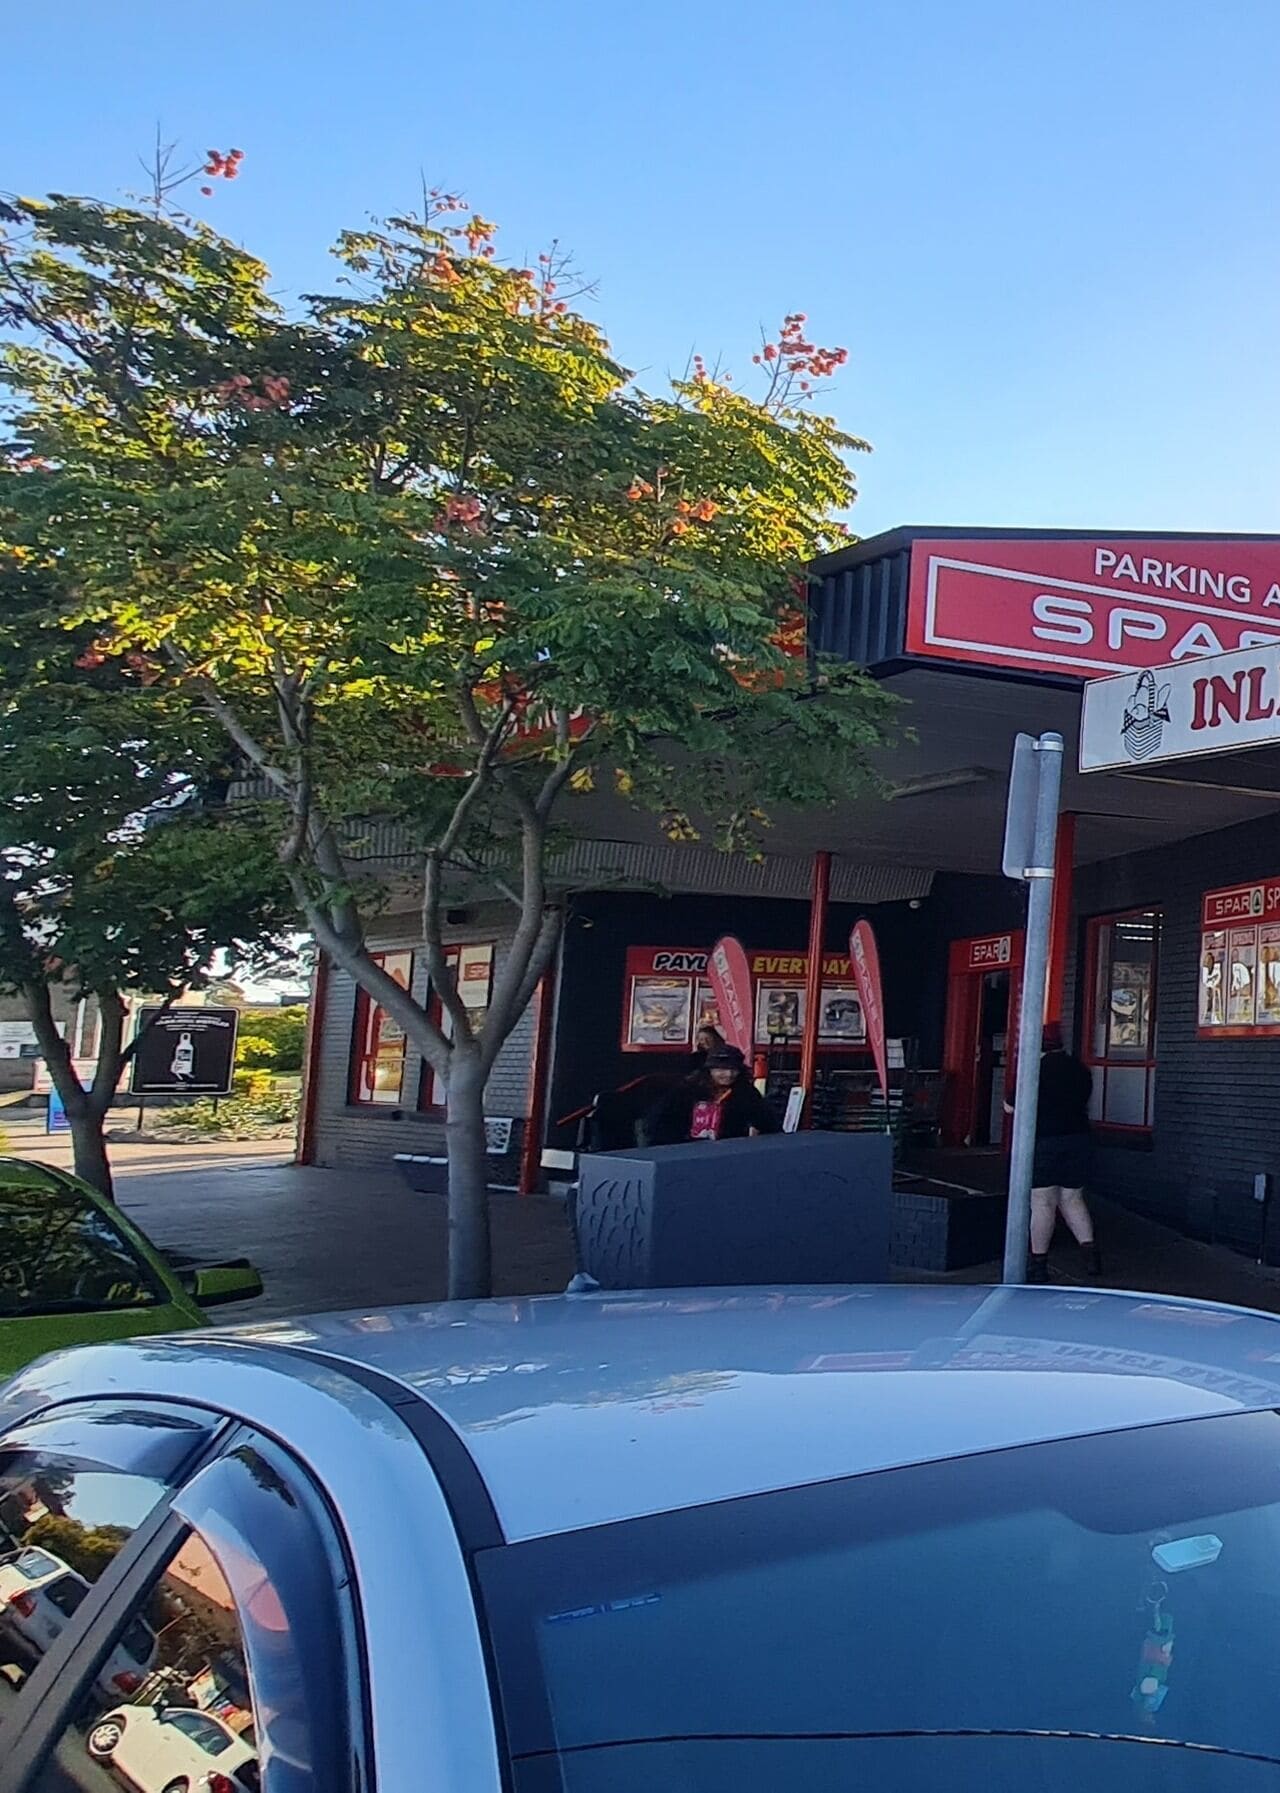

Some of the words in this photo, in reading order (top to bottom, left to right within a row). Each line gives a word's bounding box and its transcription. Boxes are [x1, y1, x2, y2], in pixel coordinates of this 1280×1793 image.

[1095, 548, 1250, 603] PARKING
[1215, 894, 1251, 916] SPAR
[973, 943, 1000, 961] SPAR
